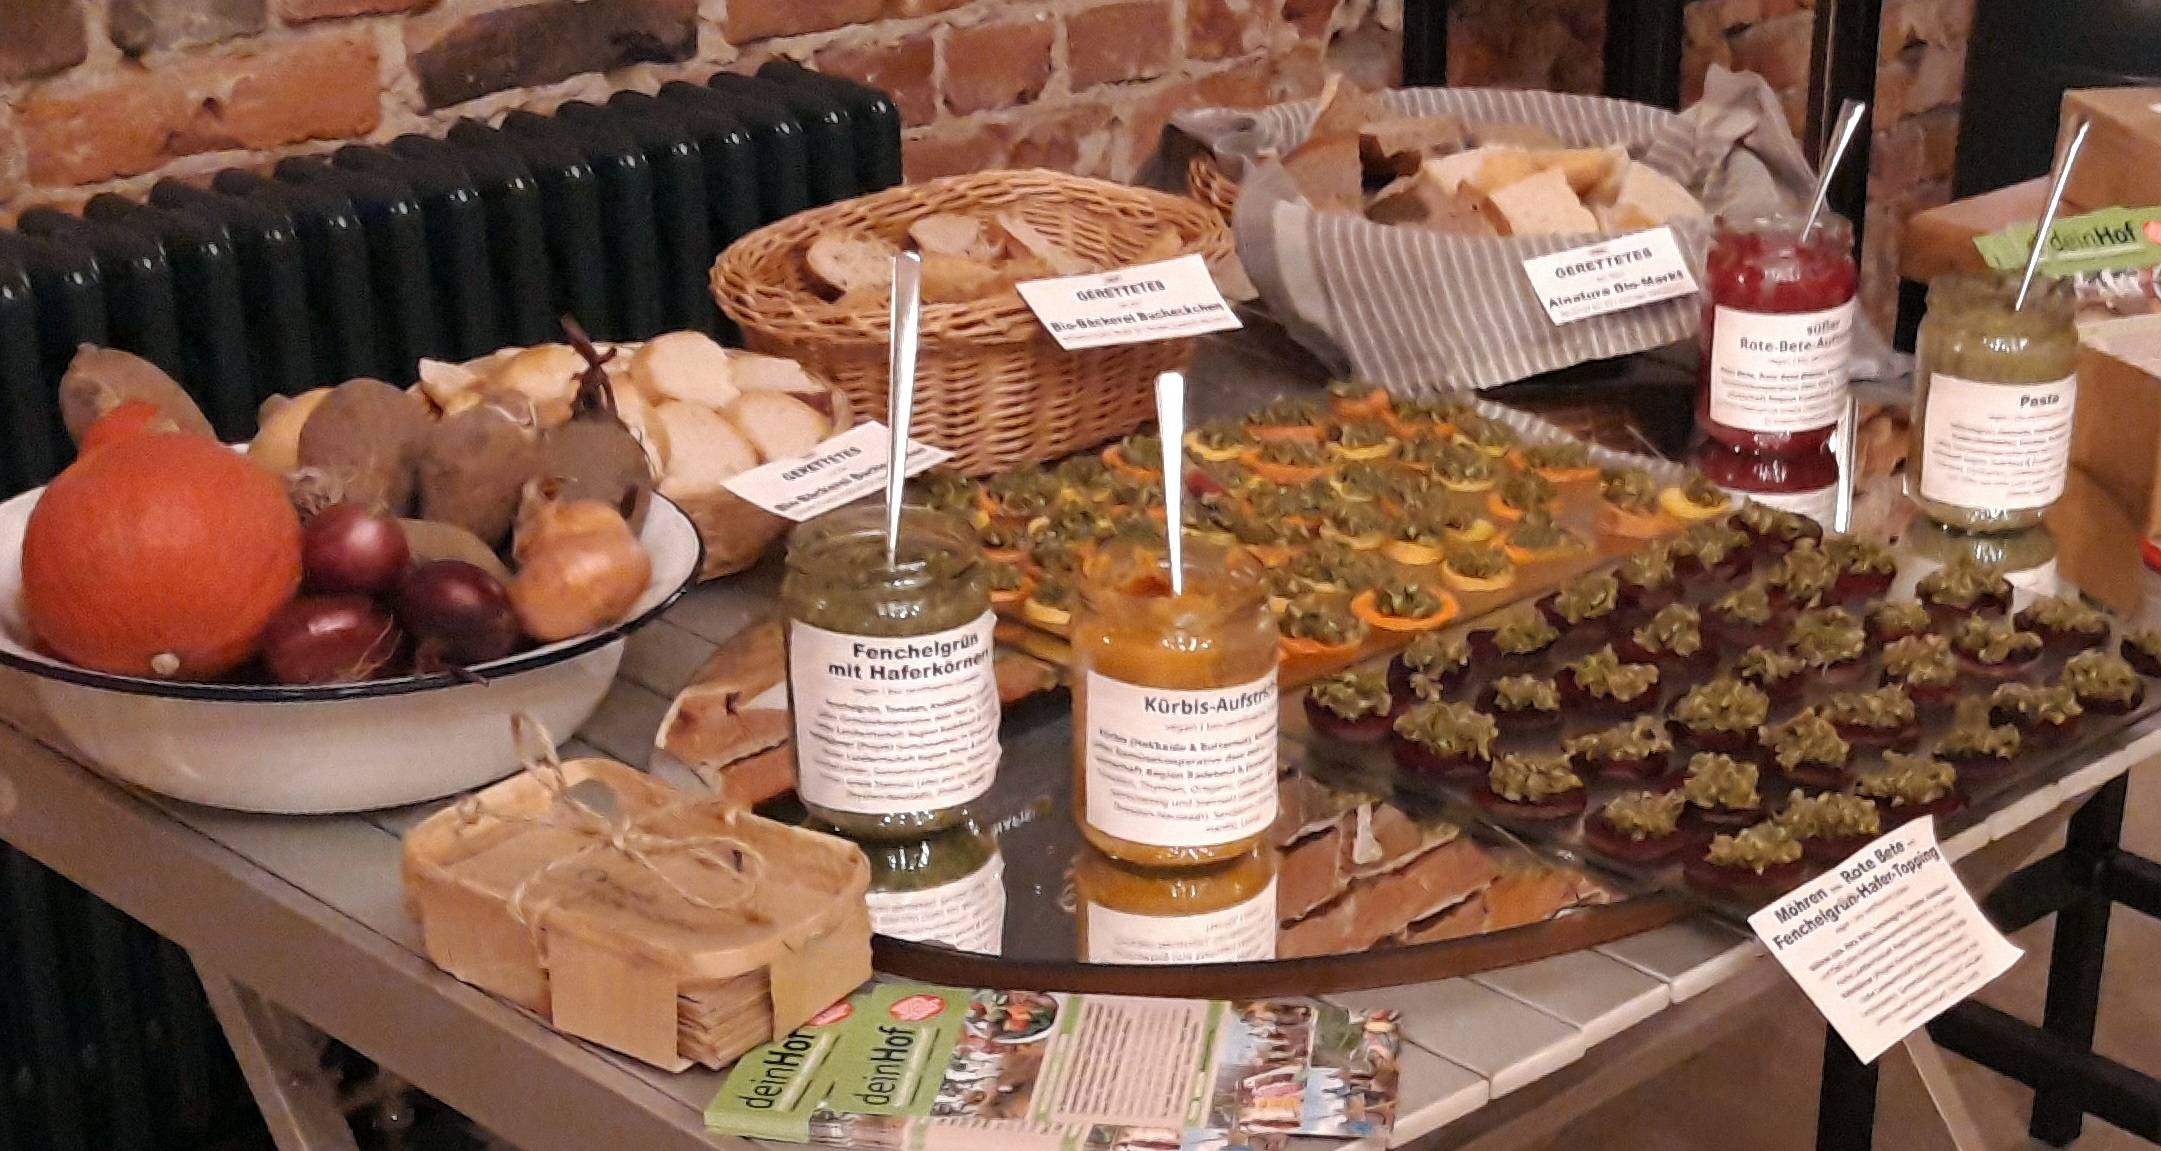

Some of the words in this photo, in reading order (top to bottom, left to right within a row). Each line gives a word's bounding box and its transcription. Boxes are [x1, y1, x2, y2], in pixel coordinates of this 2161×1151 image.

[1555, 247, 1653, 279] GERETTETES
[1076, 279, 1167, 302] GERETTETES
[853, 632, 979, 660] Fenchelgrün
[829, 664, 863, 680] mit
[1773, 888, 1829, 924] Möhren
[1839, 857, 1877, 884] Rote
[1873, 840, 1906, 864] Bete
[853, 1025, 915, 1107] deinHof
